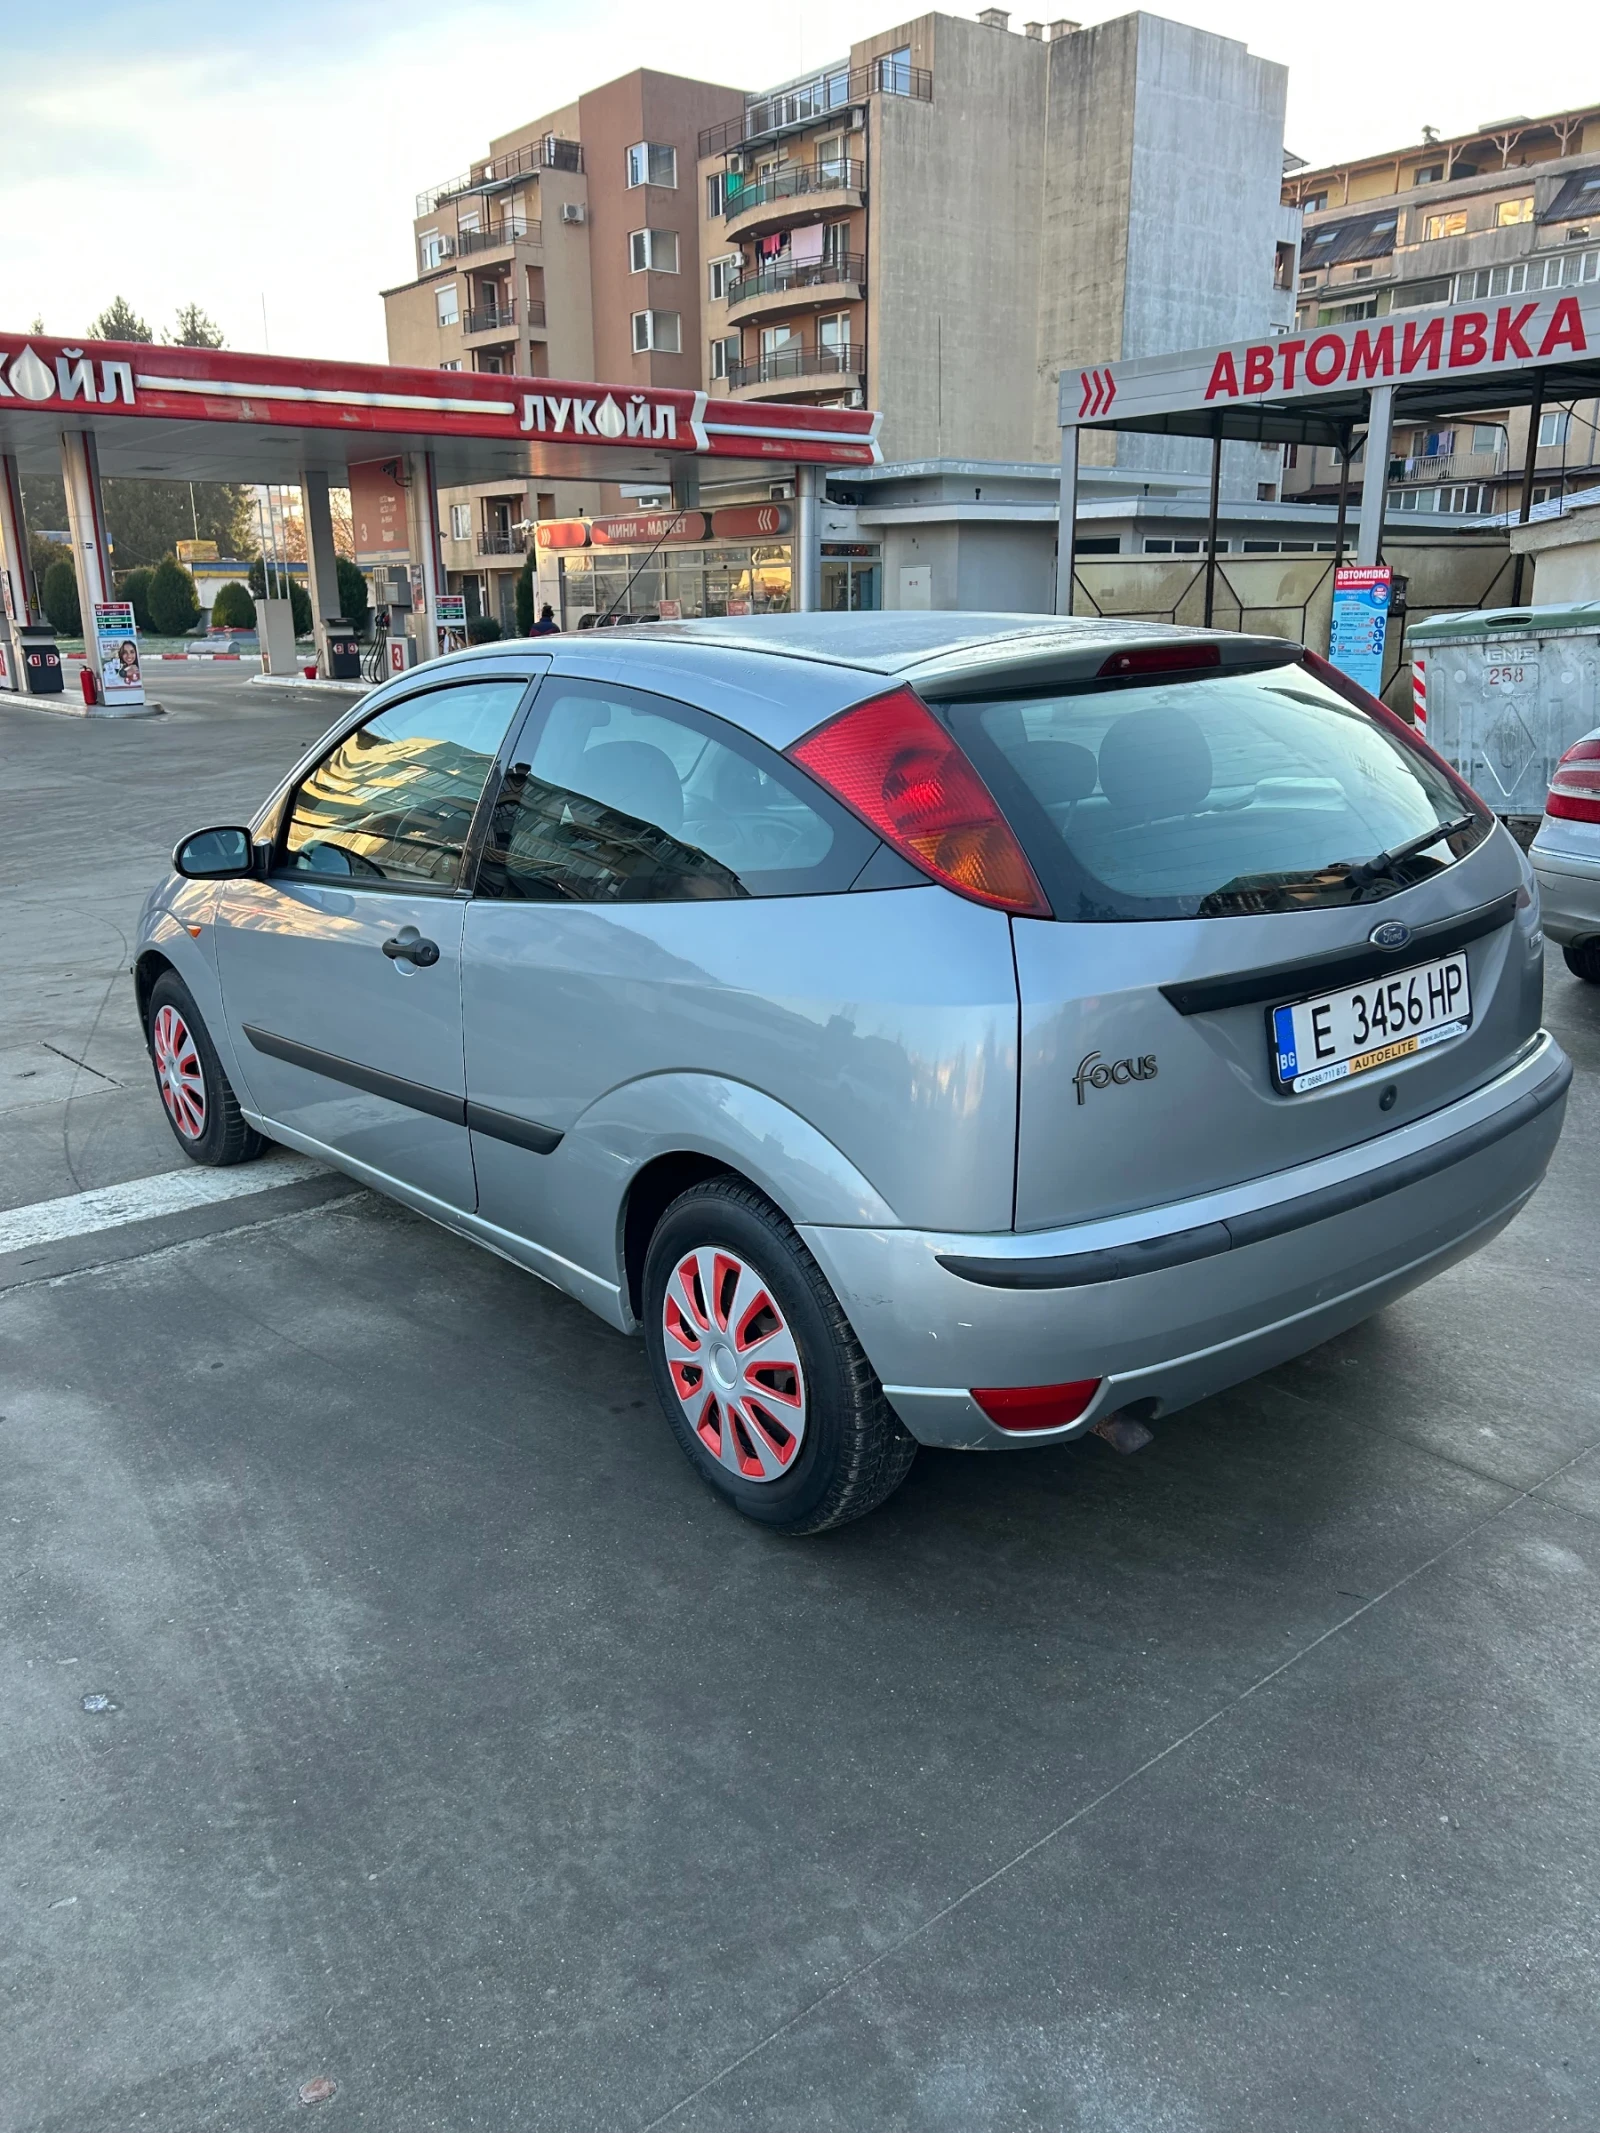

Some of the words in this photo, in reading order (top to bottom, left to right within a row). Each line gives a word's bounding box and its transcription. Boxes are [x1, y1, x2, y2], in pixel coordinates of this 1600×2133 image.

[1204, 296, 1588, 400] АВТОМИВКА
[520, 392, 677, 440] ЛУКОЙЛ
[361, 523, 368, 541] 3
[607, 522, 637, 539] МИНИ
[647, 518, 687, 536] МАРКЕТ
[48, 656, 55, 664] 2
[393, 647, 401, 667] 3
[1489, 667, 1524, 685] 258
[1382, 927, 1404, 944] Ford
[1351, 976, 1423, 1045] 3456
[1279, 1052, 1297, 1070] BG
[1353, 1040, 1414, 1071] AUTOELITE
